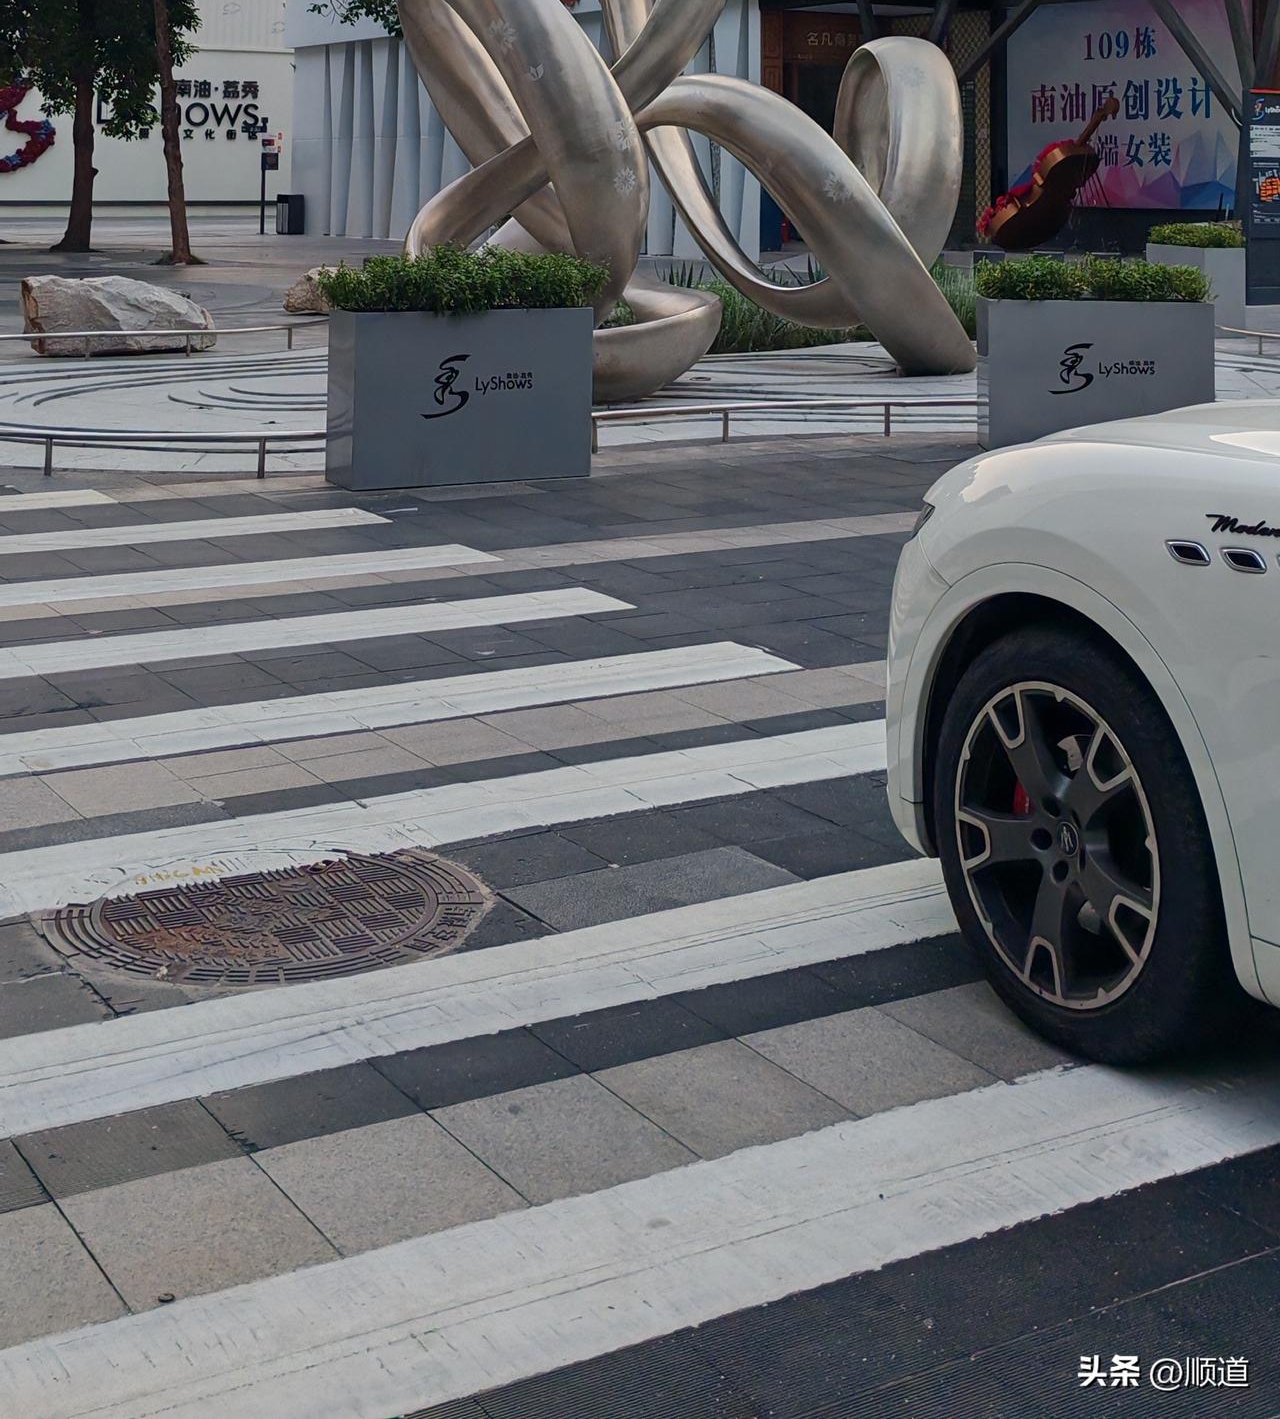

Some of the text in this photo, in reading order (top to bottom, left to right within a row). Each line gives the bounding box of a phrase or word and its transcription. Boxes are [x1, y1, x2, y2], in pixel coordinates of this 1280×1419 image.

[1083, 27, 1157, 61] 109栋
[1031, 77, 1213, 123] 南油原创设计
[1096, 132, 1172, 167] 端女装
[475, 376, 533, 395] LyShows
[1098, 362, 1156, 378] LyShows
